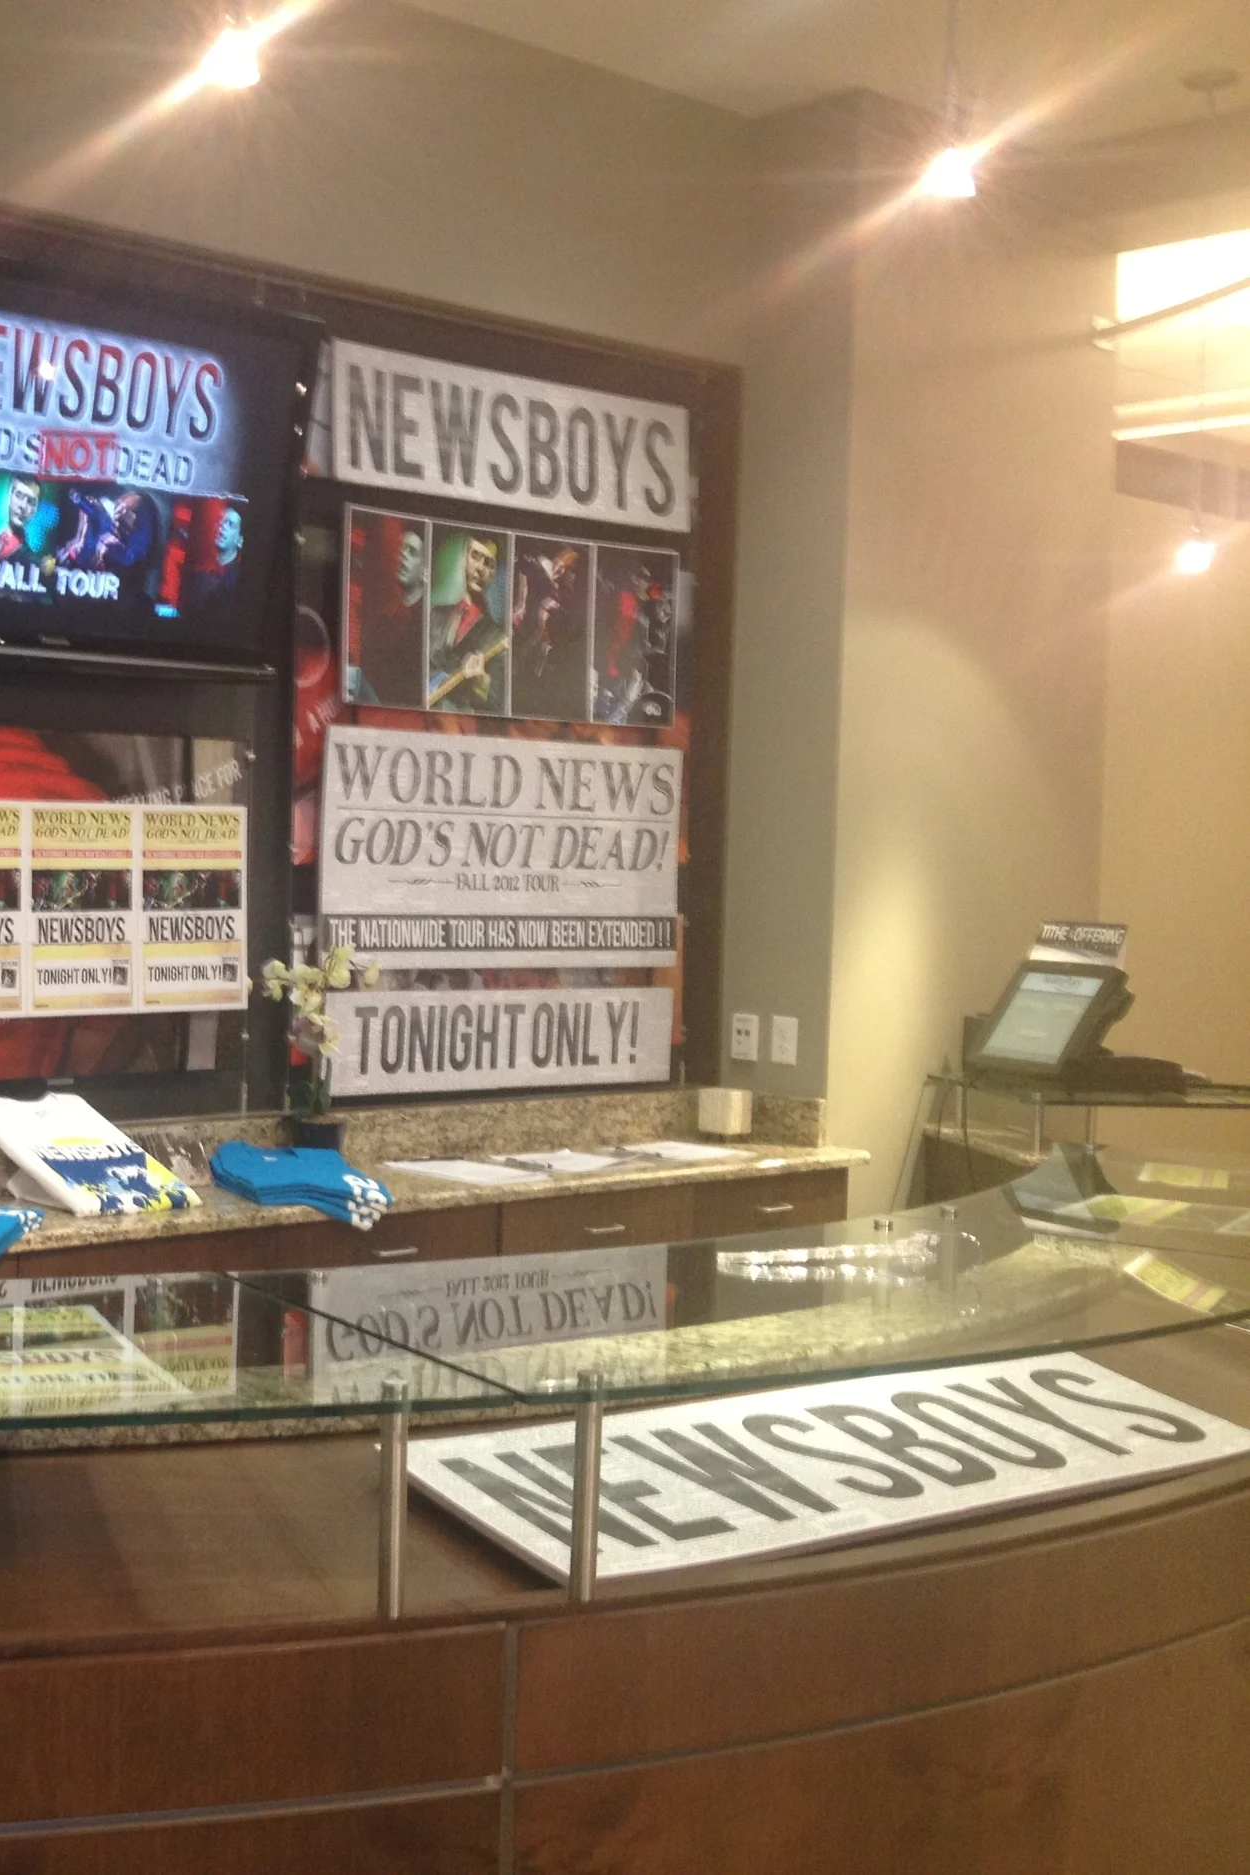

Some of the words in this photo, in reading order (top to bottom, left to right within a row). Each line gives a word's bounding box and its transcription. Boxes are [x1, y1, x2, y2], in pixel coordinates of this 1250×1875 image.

[347, 363, 676, 518] NEWSBOYS
[43, 438, 115, 474] NOT
[117, 446, 195, 487] DEAD
[56, 568, 120, 601] TOUR
[335, 742, 522, 810] WORLD
[535, 757, 675, 817] NEWS
[34, 810, 86, 825] WORLD
[89, 812, 131, 826] NEWS
[145, 813, 197, 827] WORLD
[200, 814, 240, 827] NEWS
[70, 827, 92, 839] NOT
[181, 829, 202, 840] NOT
[335, 817, 455, 868] GOD'S
[462, 823, 545, 870] NOT
[550, 824, 670, 872] DEAD!
[455, 872, 490, 892] FALL
[493, 874, 520, 892] 2012
[523, 874, 560, 892] TOUR
[38, 917, 126, 944] NEWSBOYS
[149, 915, 236, 942] NEWSBOYS
[329, 918, 357, 948] THE
[359, 919, 447, 948] NATIONWIDE
[449, 920, 486, 948] TOUR
[488, 921, 516, 948] HAS
[517, 921, 548, 948] NOW
[551, 921, 586, 948] BEEN
[1074, 927, 1125, 944] OFFERING
[37, 968, 81, 985] TONIGHT
[81, 966, 112, 984] ONLY!
[148, 966, 191, 982] TONIGHT
[191, 965, 222, 981] ONLY!
[355, 1003, 527, 1076] TONIGHT
[530, 1001, 640, 1069] ONLY!
[439, 1369, 1207, 1554] NEWSBOYS
